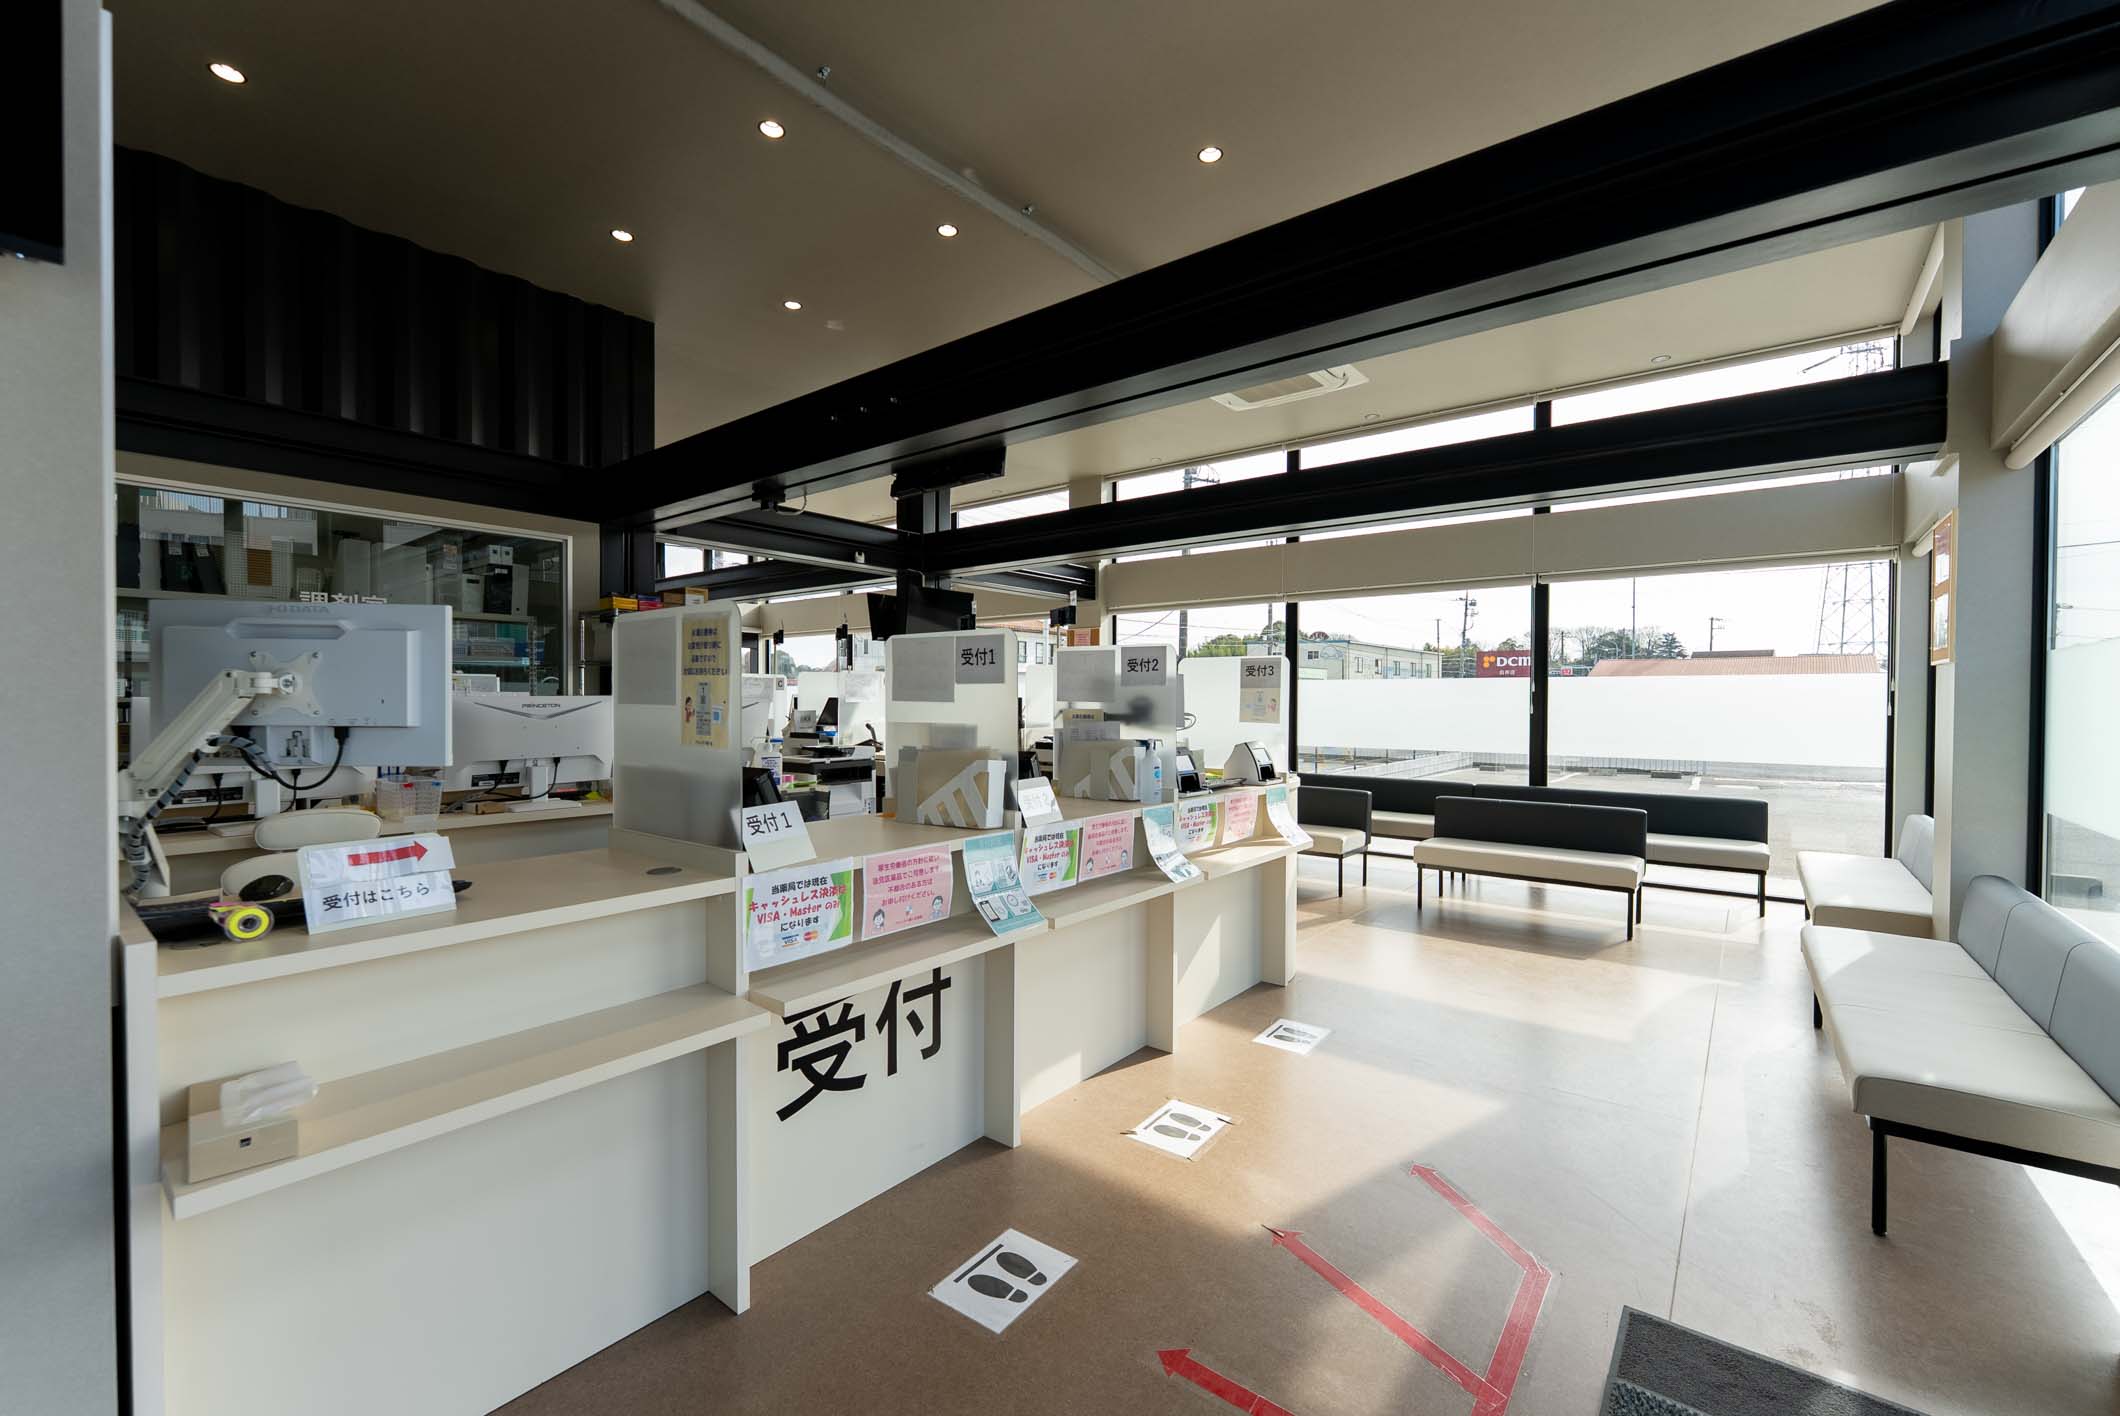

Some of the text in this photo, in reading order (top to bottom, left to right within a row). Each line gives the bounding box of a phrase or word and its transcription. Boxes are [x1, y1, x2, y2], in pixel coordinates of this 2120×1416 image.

[961, 647, 996, 665] 受付1
[1127, 657, 1159, 673] 受付2
[1245, 664, 1274, 677] 受付3
[777, 680, 783, 688] C
[745, 812, 793, 836] 受付1
[771, 876, 828, 895] 当薬局では現在
[322, 882, 430, 911] 受付はこちら
[780, 915, 819, 932] になります
[776, 966, 952, 1123] 受付
